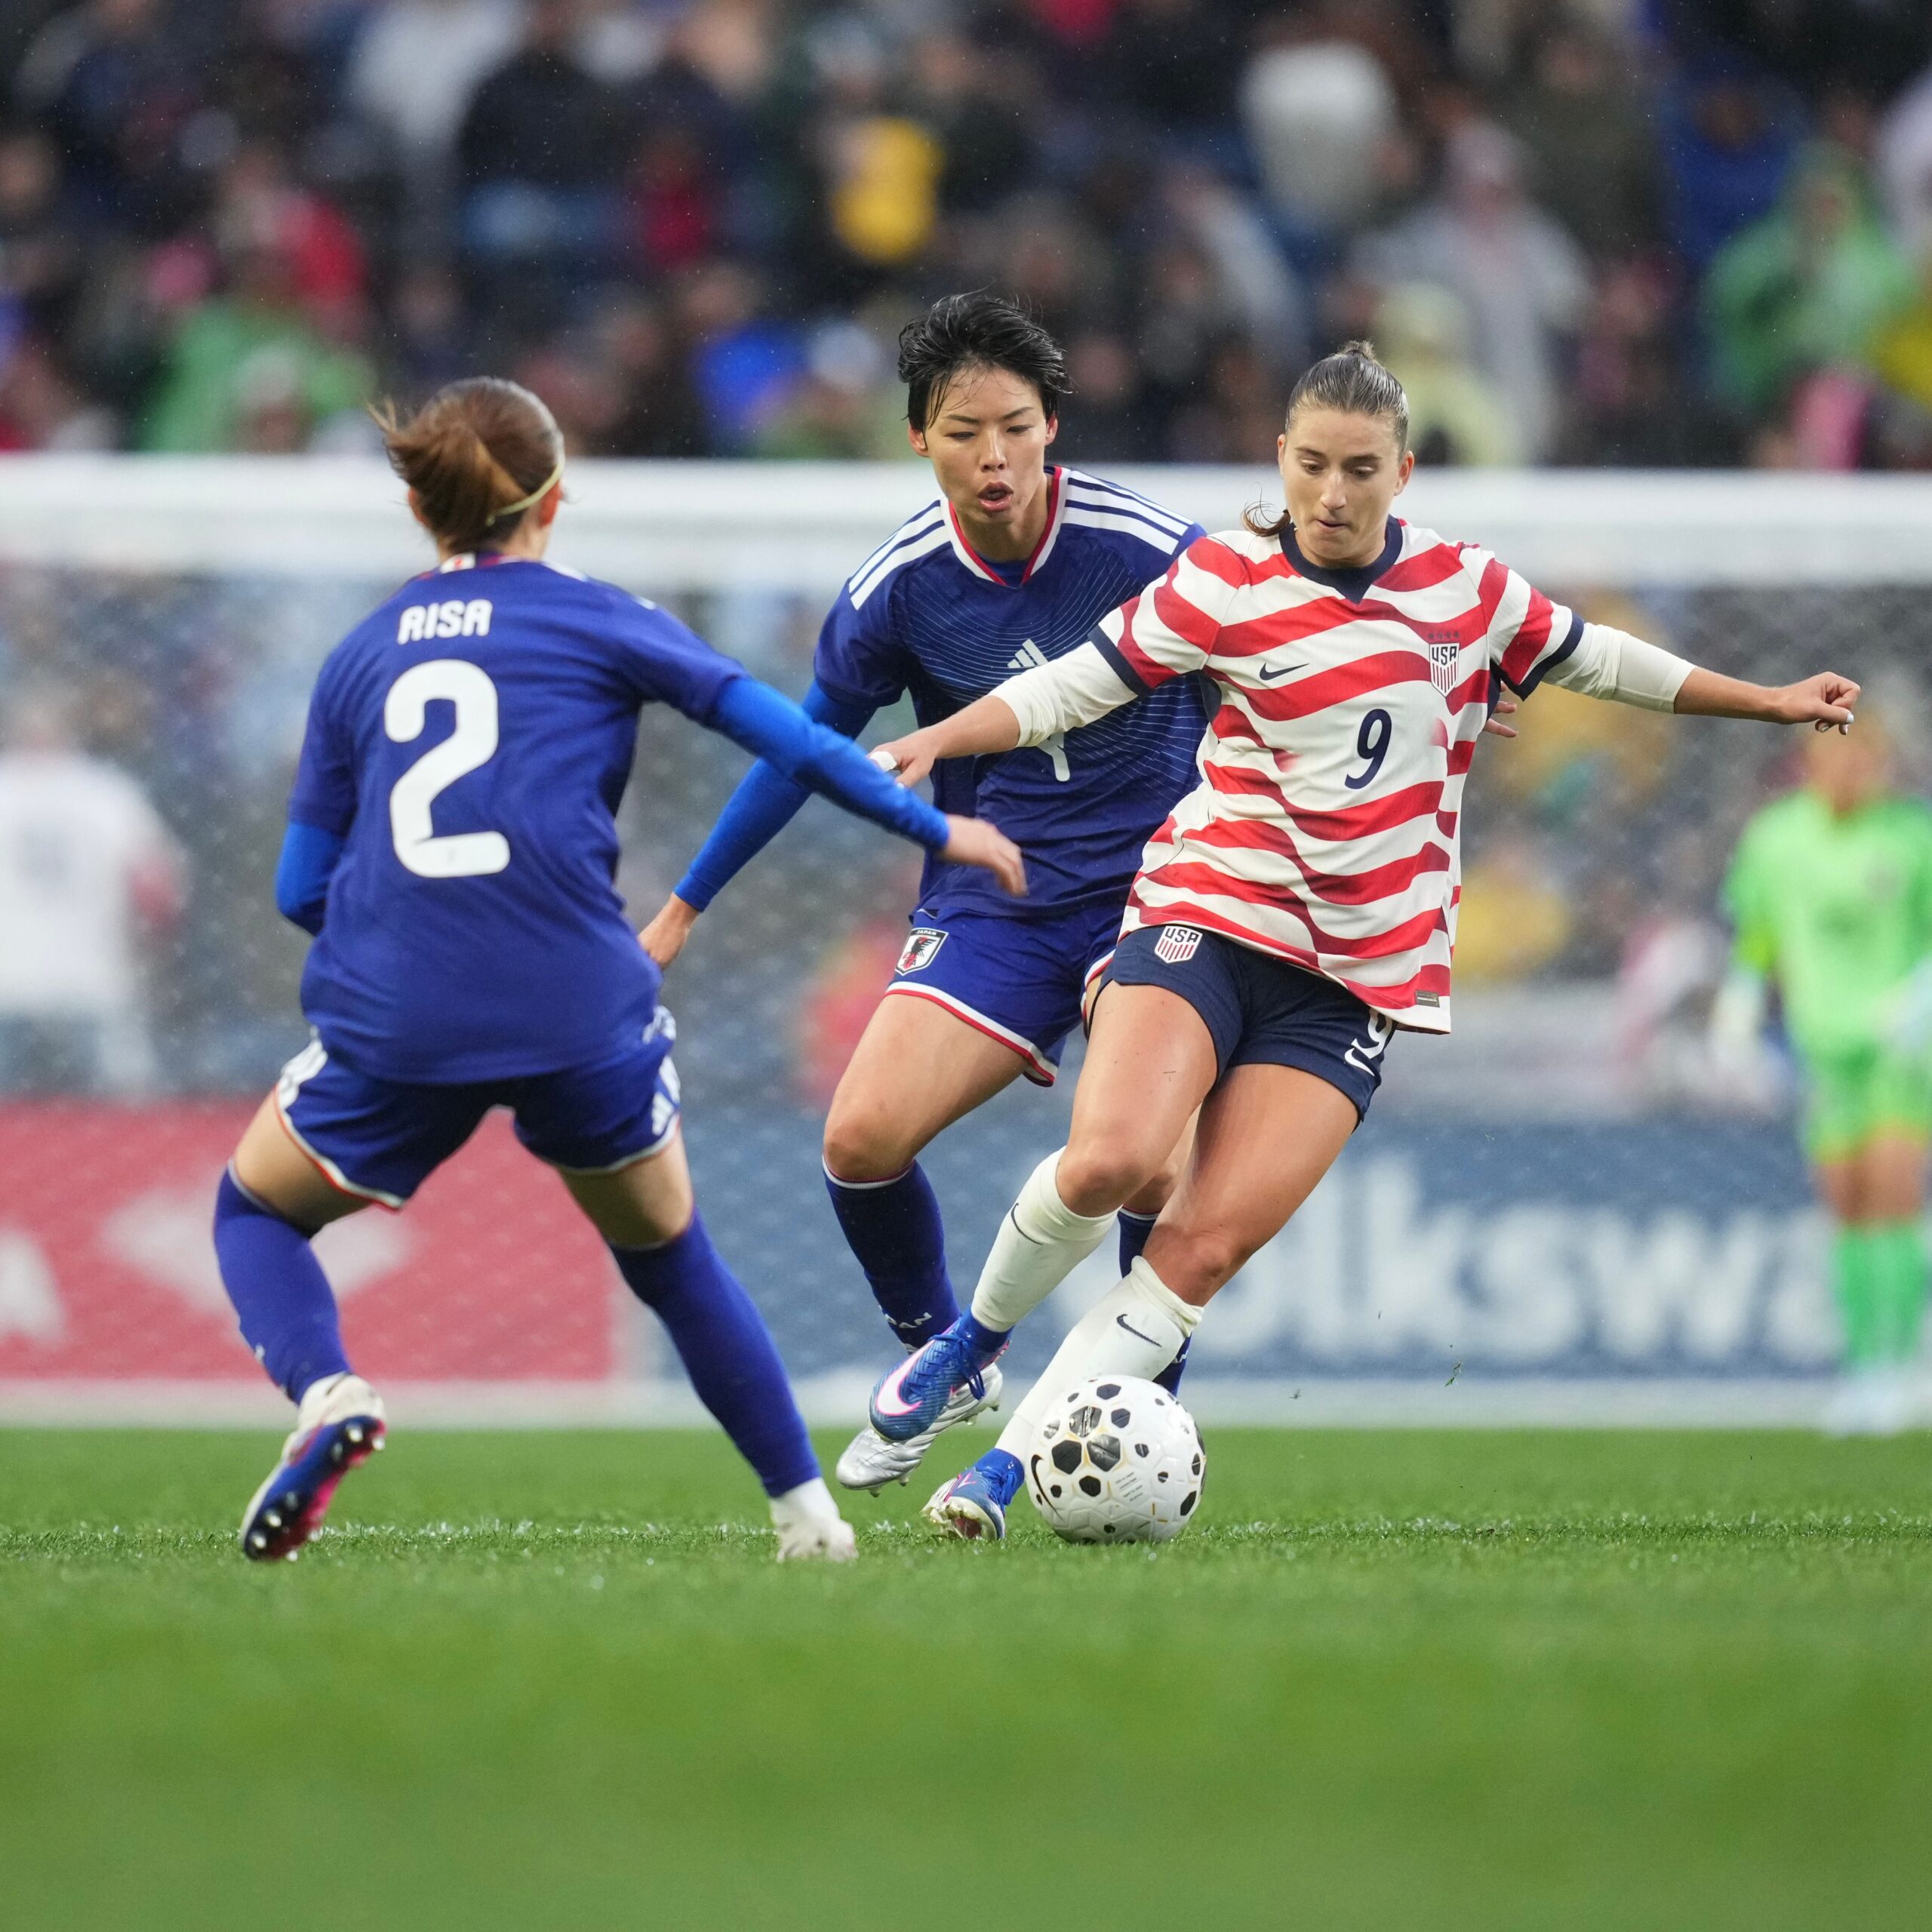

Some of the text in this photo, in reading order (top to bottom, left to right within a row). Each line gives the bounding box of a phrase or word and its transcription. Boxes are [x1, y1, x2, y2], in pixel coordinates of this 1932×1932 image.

[397, 598, 493, 645] RISA
[1431, 645, 1457, 666] USA
[384, 659, 510, 878] 2
[1344, 709, 1392, 789] 9
[1164, 928, 1199, 943] USA
[1350, 1007, 1393, 1060] 9
